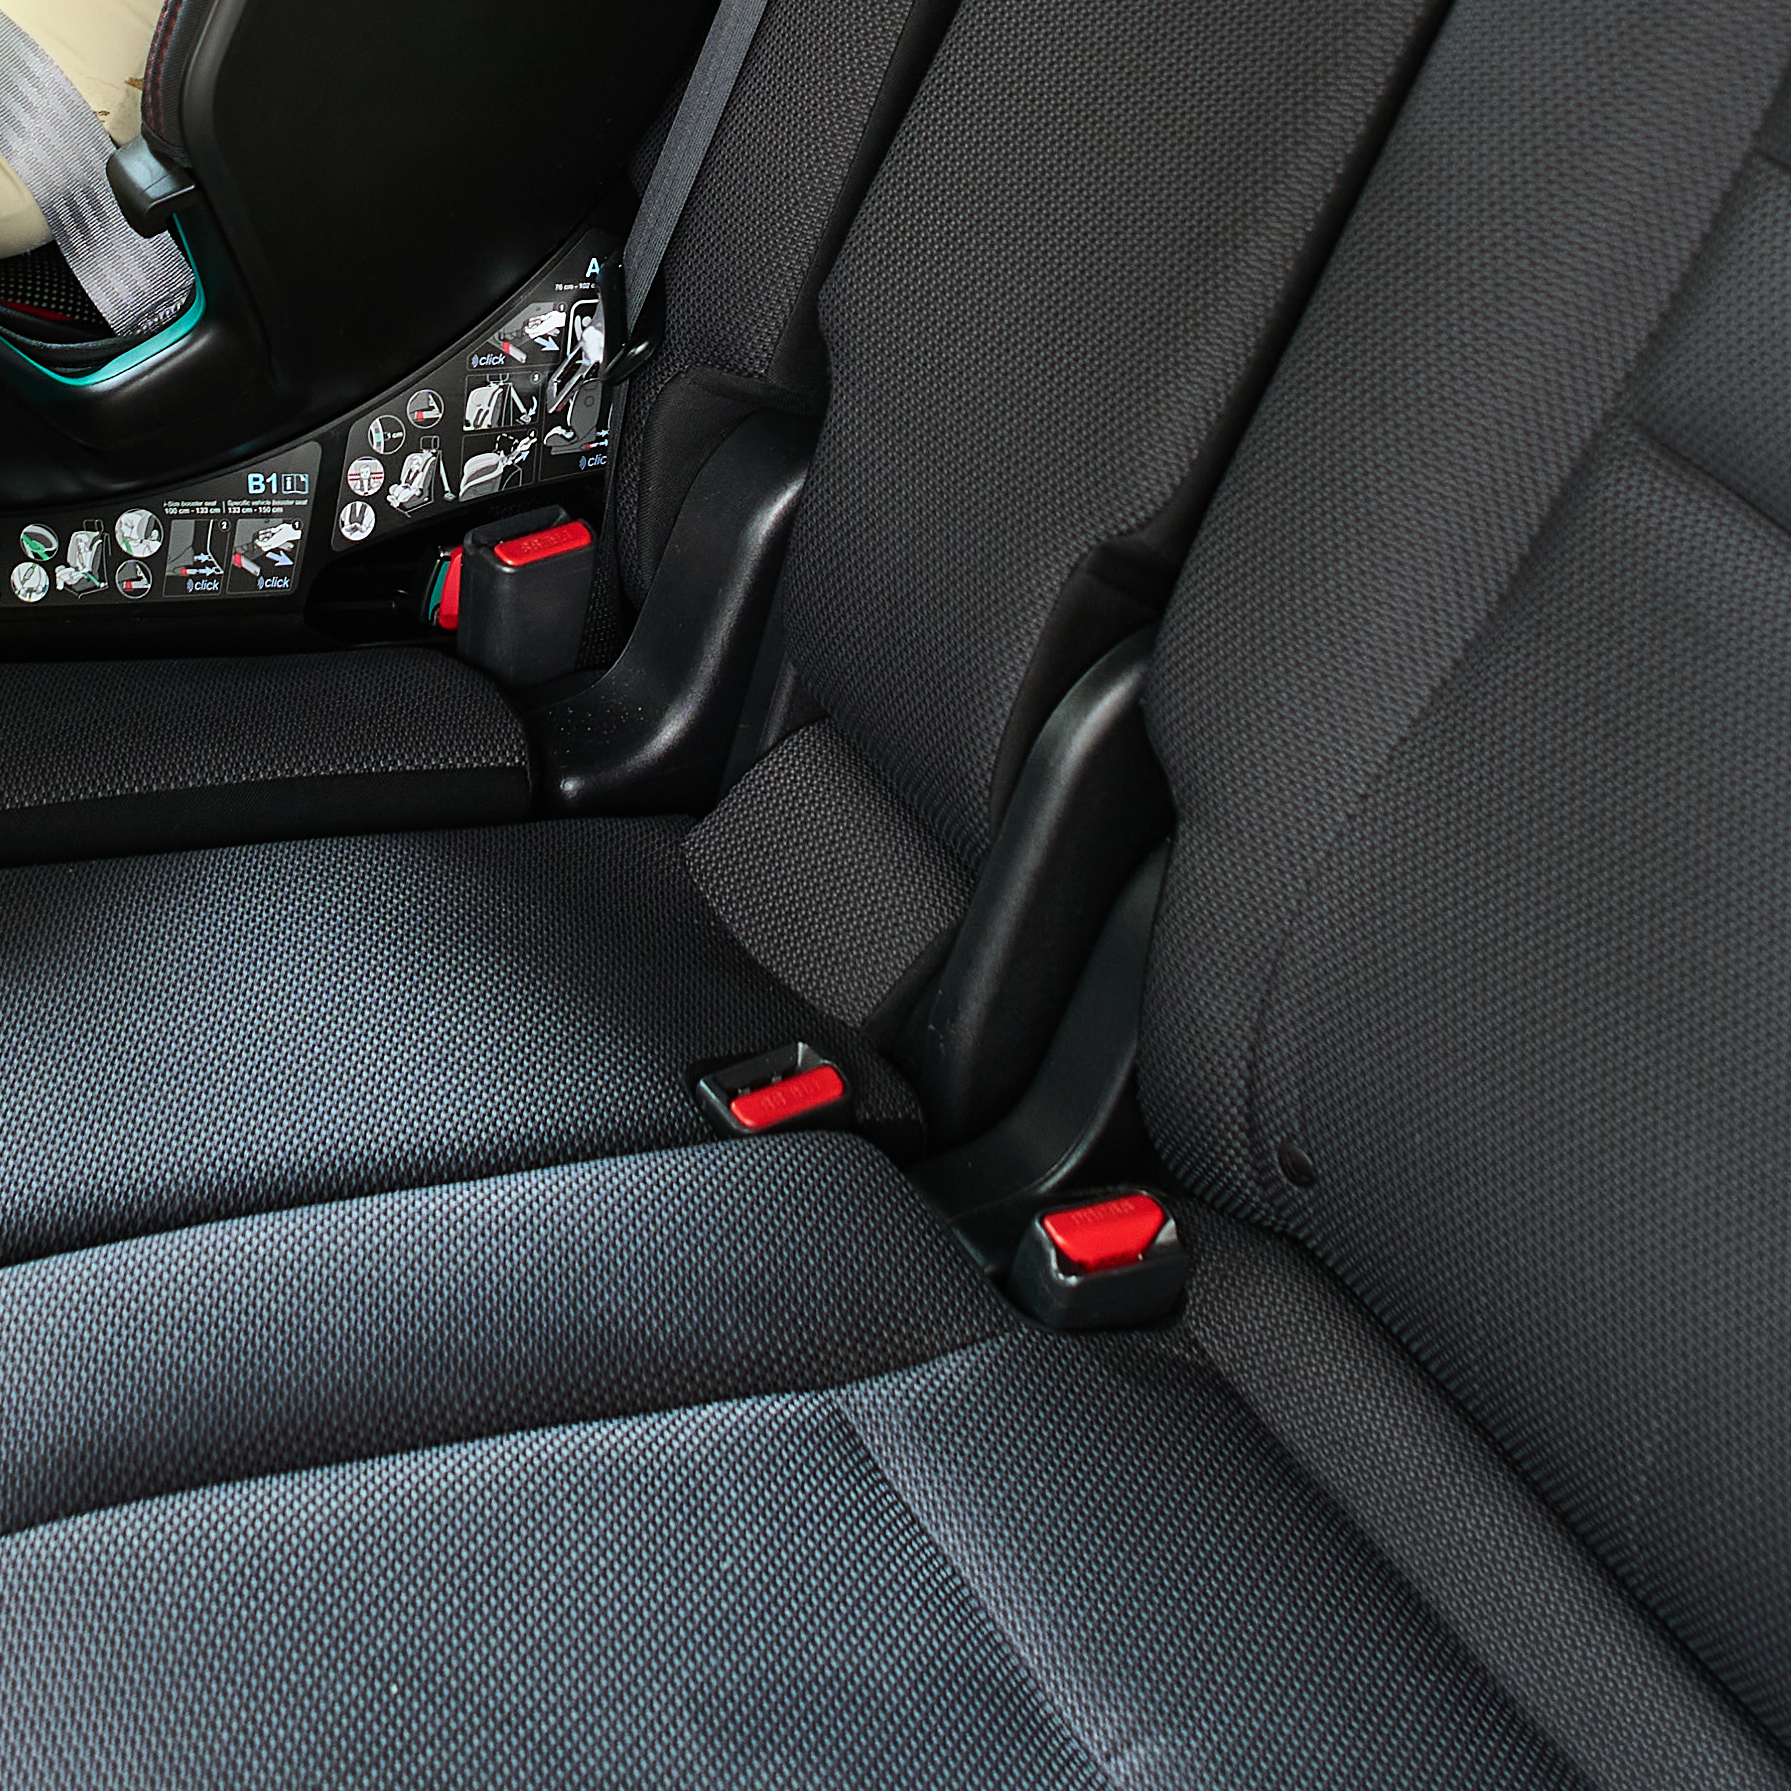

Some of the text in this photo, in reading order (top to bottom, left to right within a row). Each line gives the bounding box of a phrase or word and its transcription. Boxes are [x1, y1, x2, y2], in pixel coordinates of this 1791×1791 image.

[585, 257, 600, 278] A
[478, 354, 506, 366] click
[587, 454, 608, 467] clic
[247, 472, 278, 494] B1
[194, 579, 219, 591] click
[264, 577, 290, 588] click
